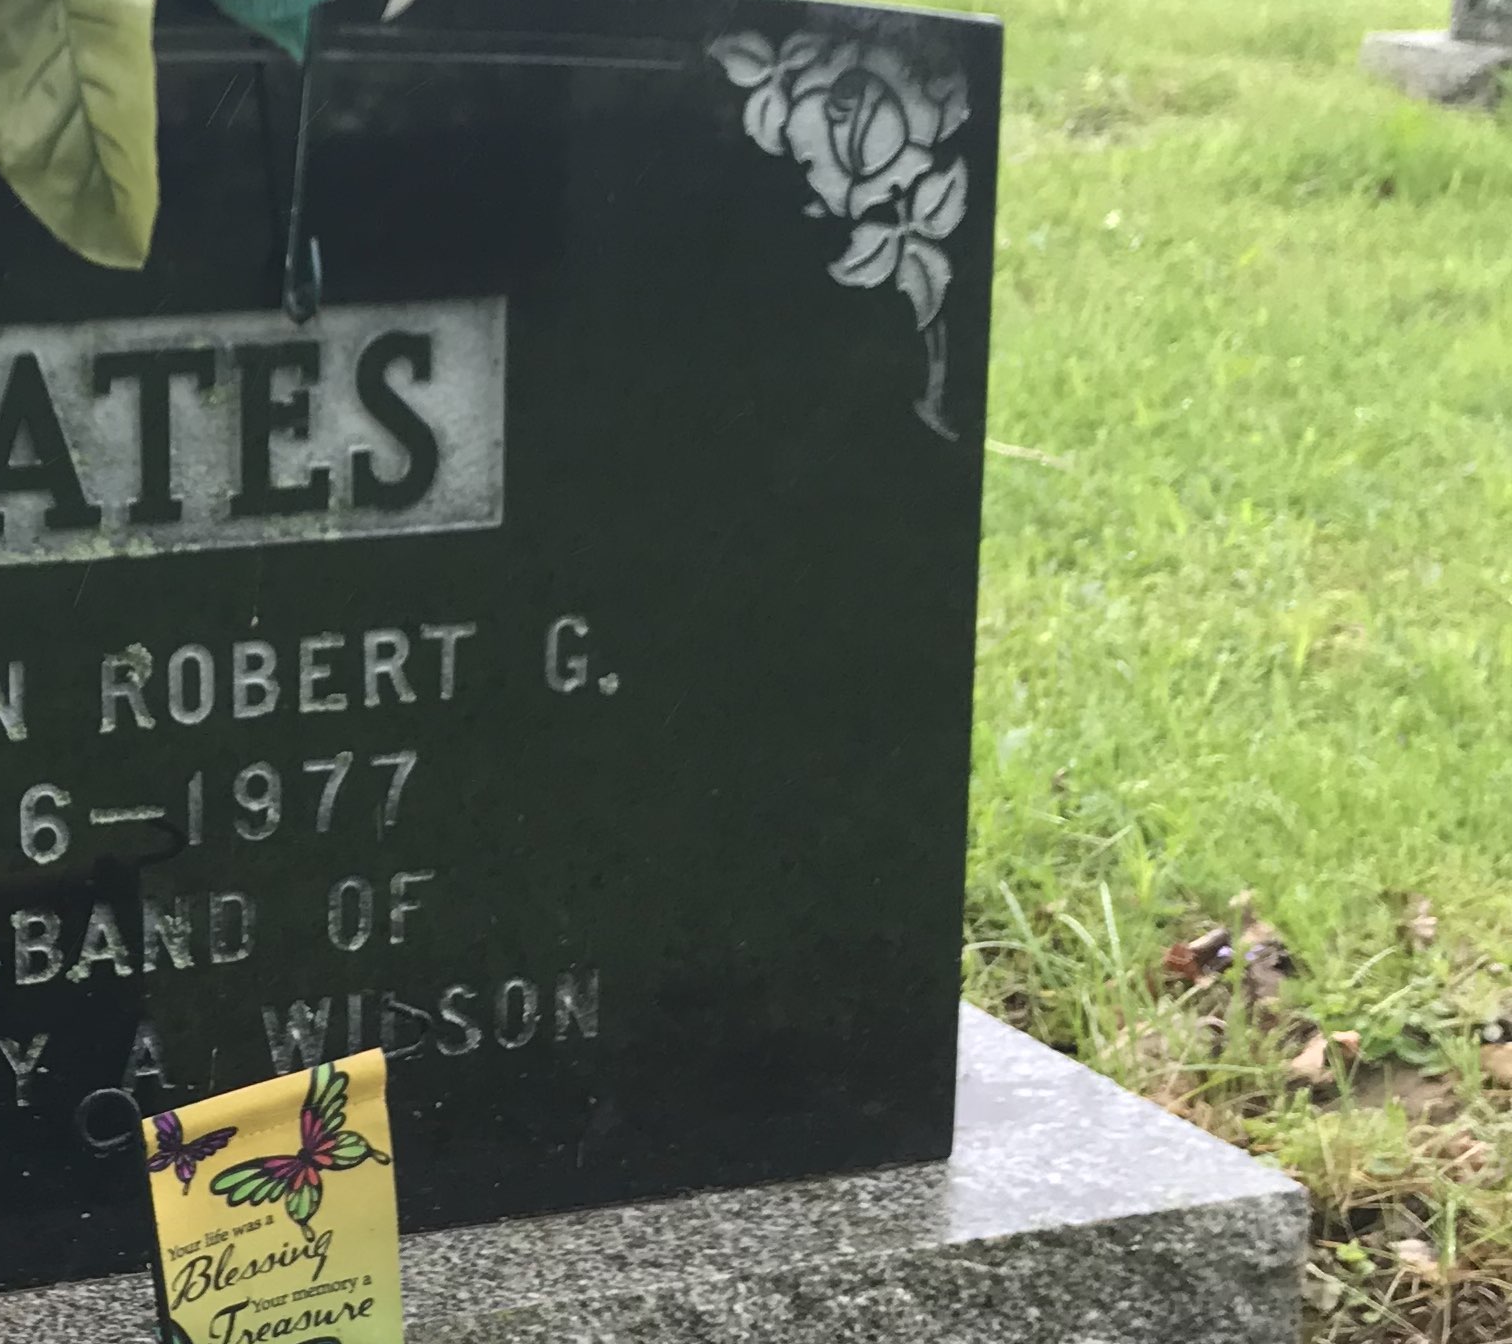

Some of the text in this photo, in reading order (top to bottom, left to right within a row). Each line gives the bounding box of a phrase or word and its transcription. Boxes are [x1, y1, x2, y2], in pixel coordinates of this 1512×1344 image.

[98, 621, 478, 736] ROBERT
[543, 614, 622, 698] G.
[327, 867, 437, 952] OF
[167, 1214, 275, 1261] Your life was a
[171, 1230, 334, 1312] Blessing
[249, 1274, 373, 1313] Your memory a
